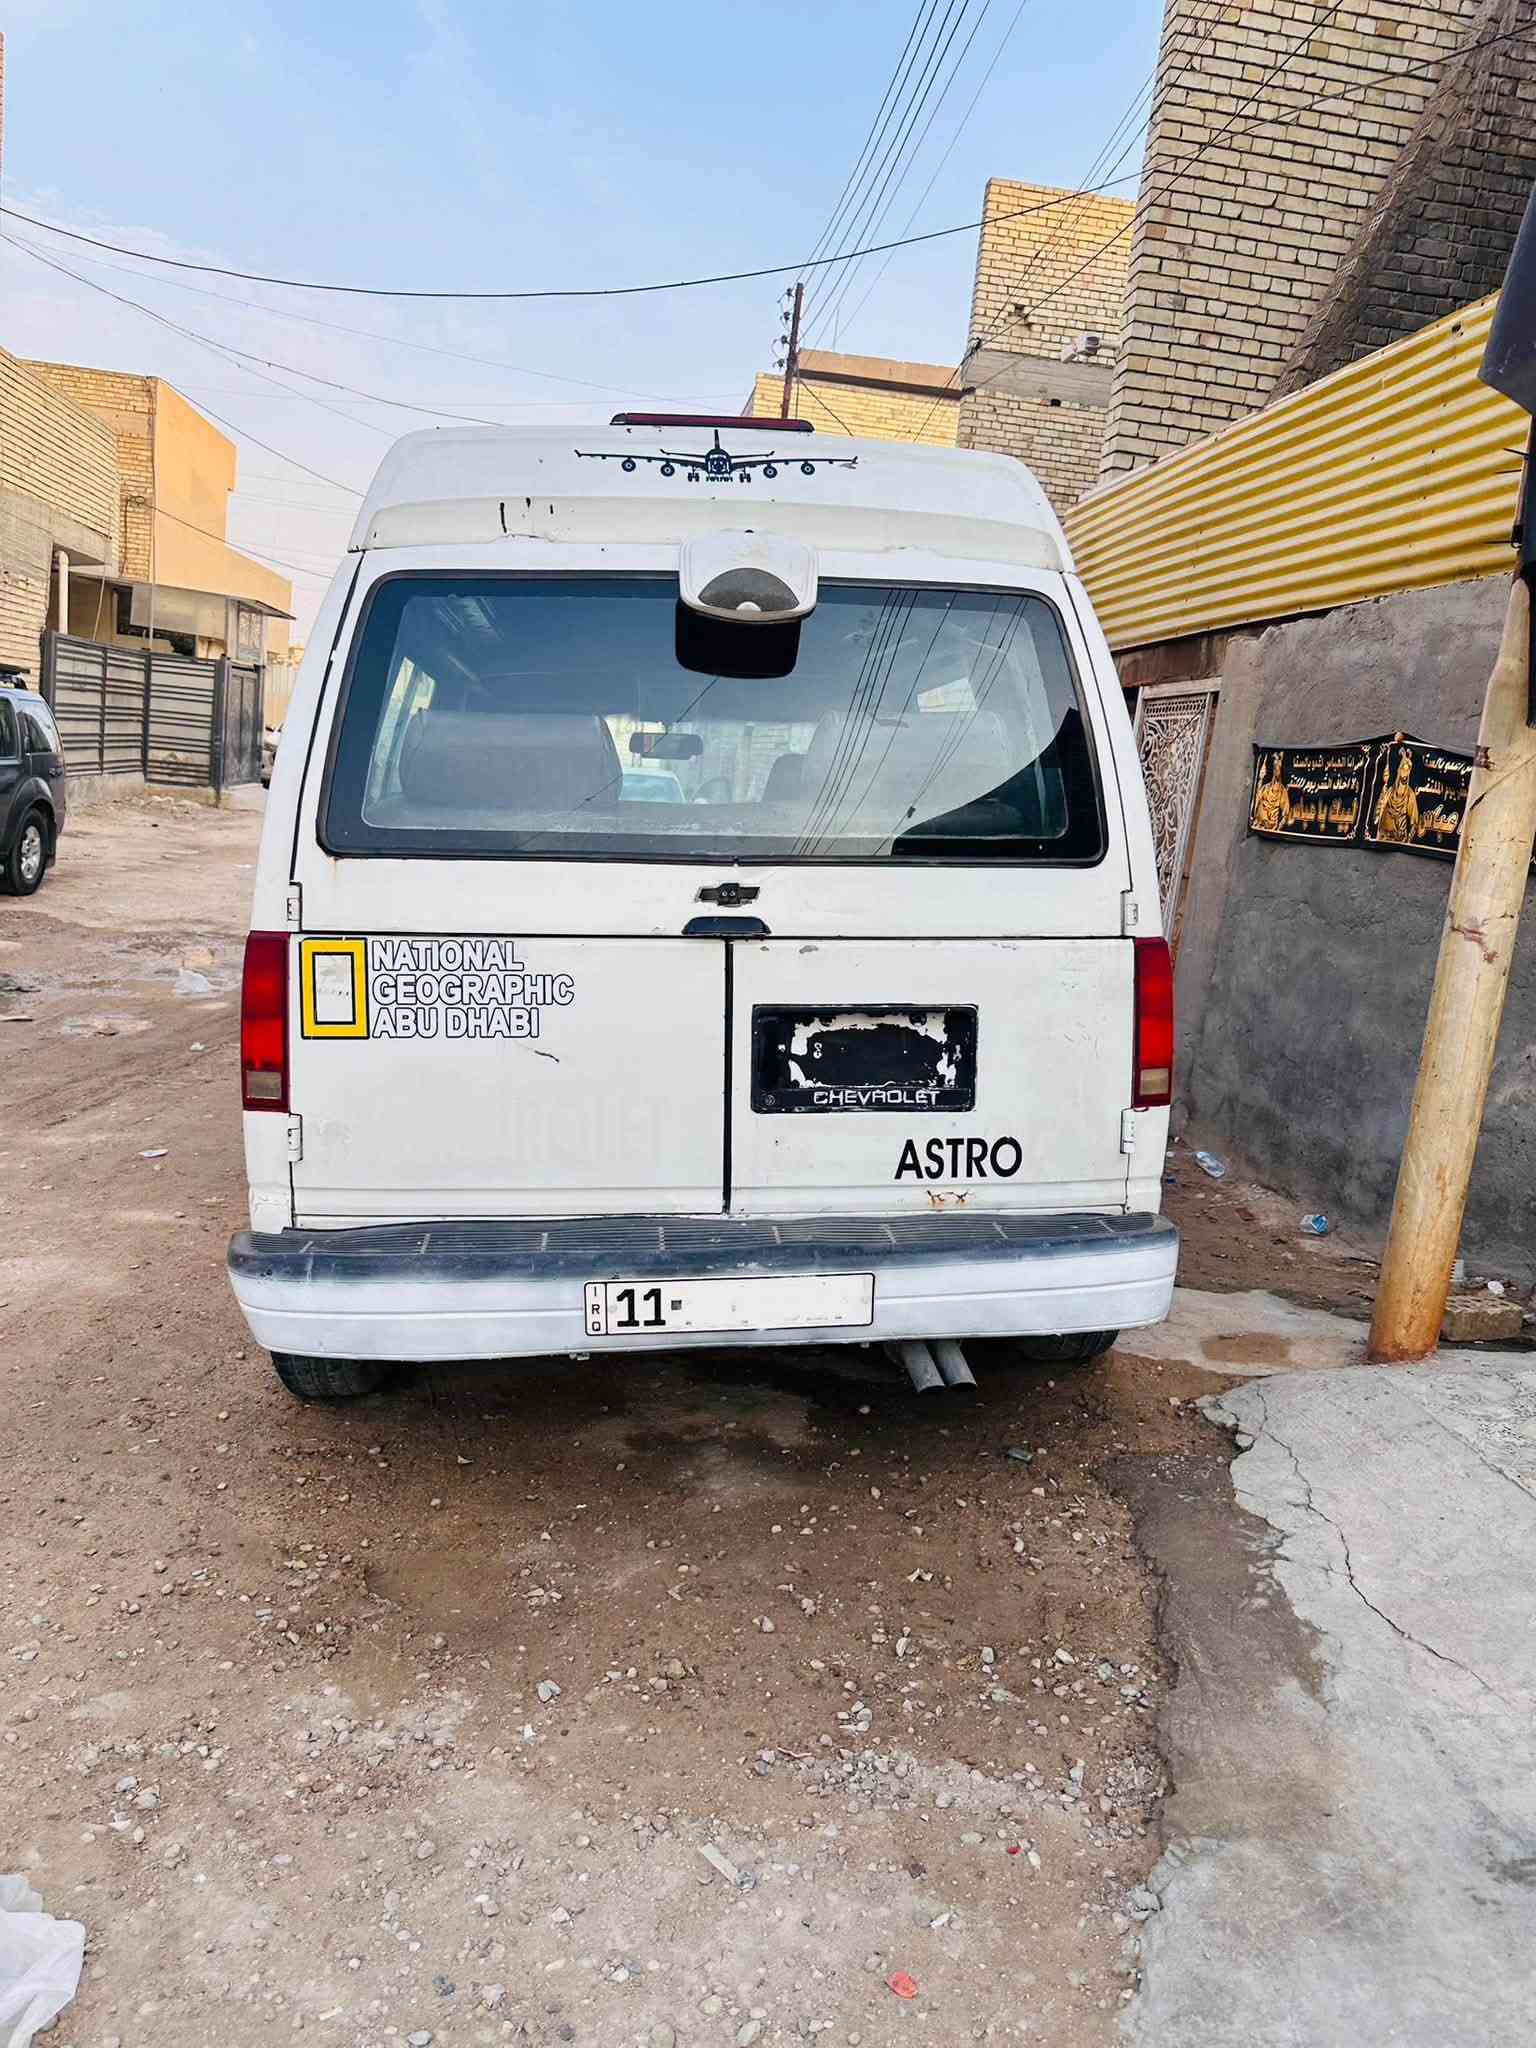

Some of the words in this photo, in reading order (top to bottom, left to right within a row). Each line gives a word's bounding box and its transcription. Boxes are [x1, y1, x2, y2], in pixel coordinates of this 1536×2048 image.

[371, 940, 525, 972] NATIONAL
[371, 973, 575, 1006] GEOGRAPHIC
[371, 1007, 439, 1039] ABU
[444, 1007, 540, 1039] DHABI
[813, 1089, 941, 1106] CHEVROLET
[894, 1136, 1023, 1180] ASTRO
